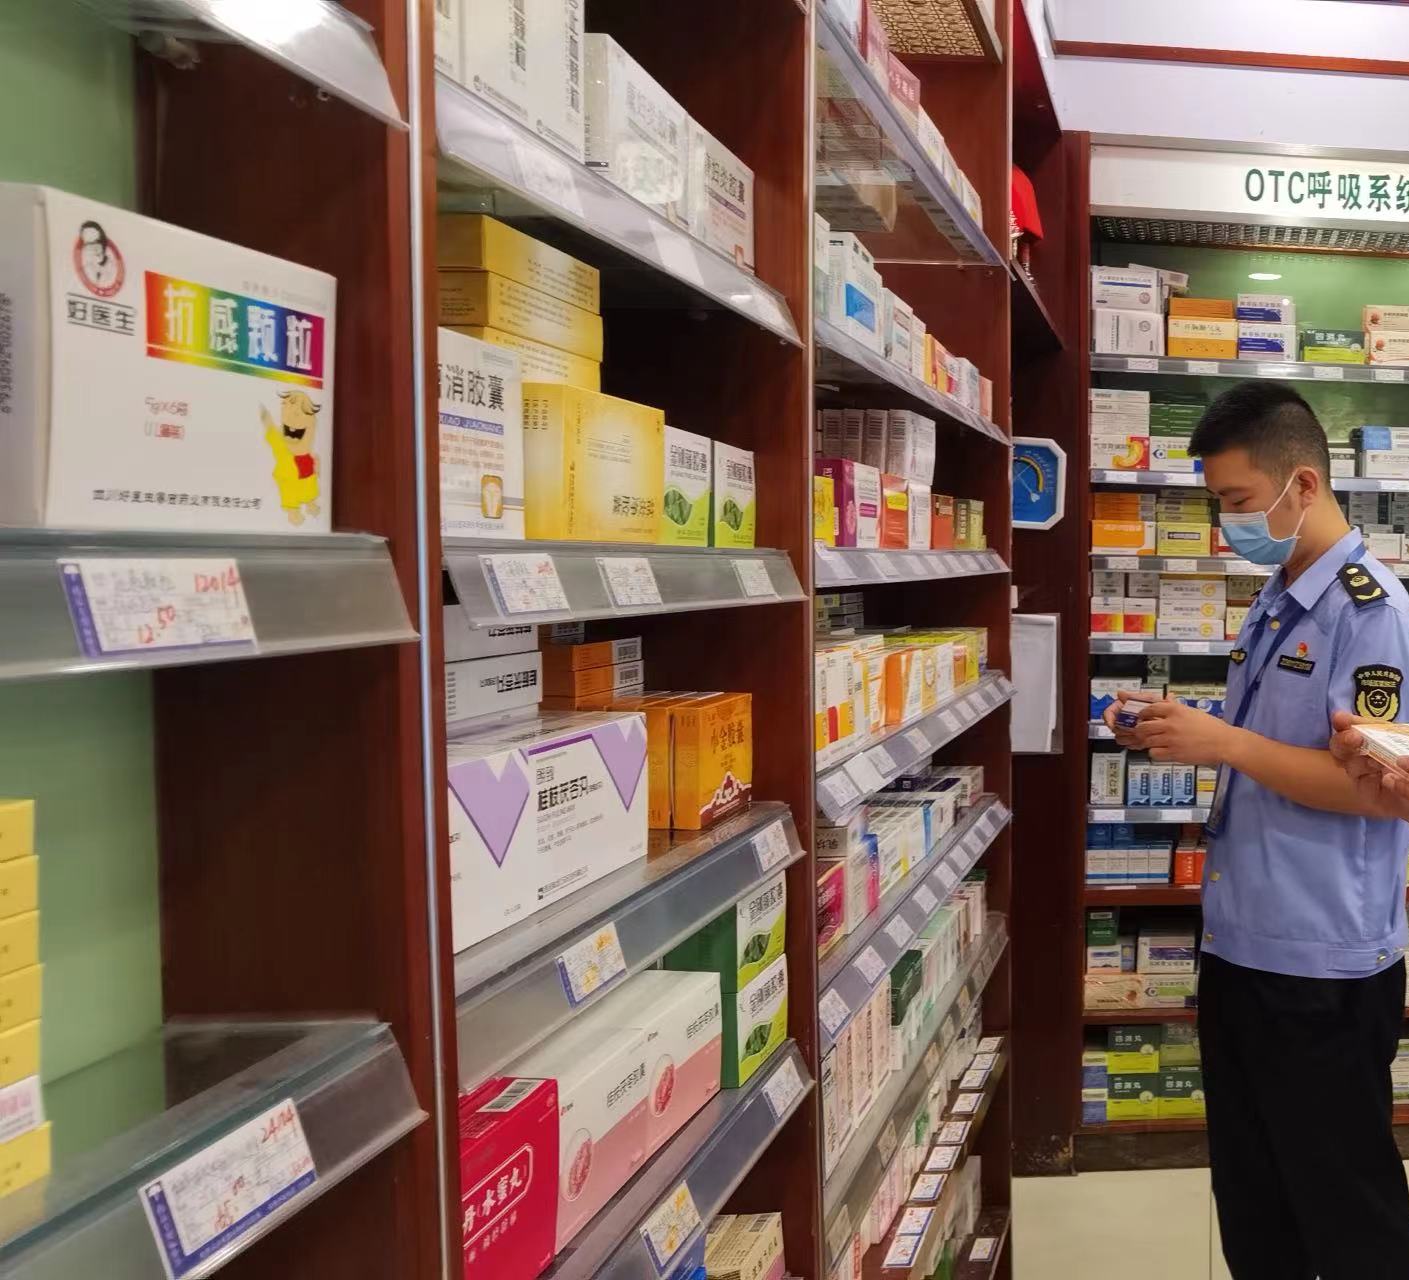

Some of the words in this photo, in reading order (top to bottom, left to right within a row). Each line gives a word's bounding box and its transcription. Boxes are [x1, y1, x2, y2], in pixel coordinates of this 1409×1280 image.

[67, 300, 136, 331] 好医生
[164, 282, 313, 370] 抗感颗粒
[439, 363, 505, 412] 消胶囊
